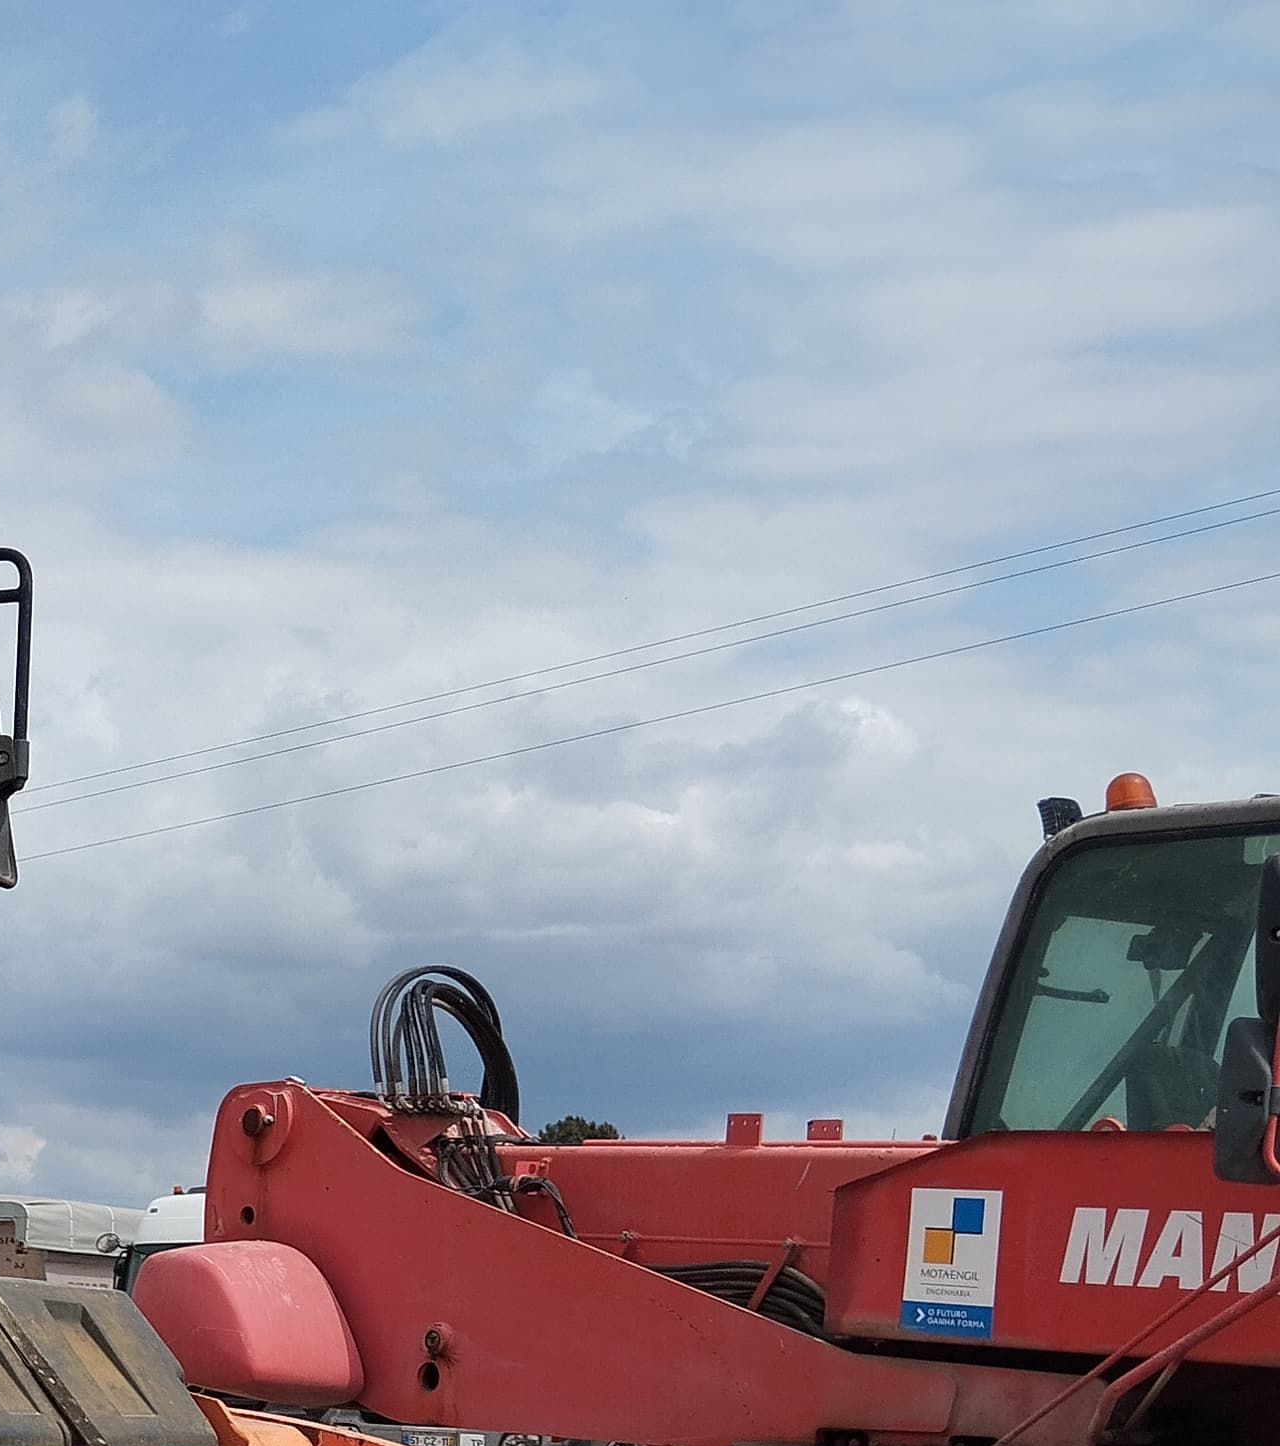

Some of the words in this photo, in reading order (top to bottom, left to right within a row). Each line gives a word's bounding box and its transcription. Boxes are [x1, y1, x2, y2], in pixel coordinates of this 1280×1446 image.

[927, 1308, 935, 1316] O
[936, 1309, 967, 1318] FUTURO
[927, 1317, 956, 1327] GANHA
[957, 1319, 985, 1329] FORMA
